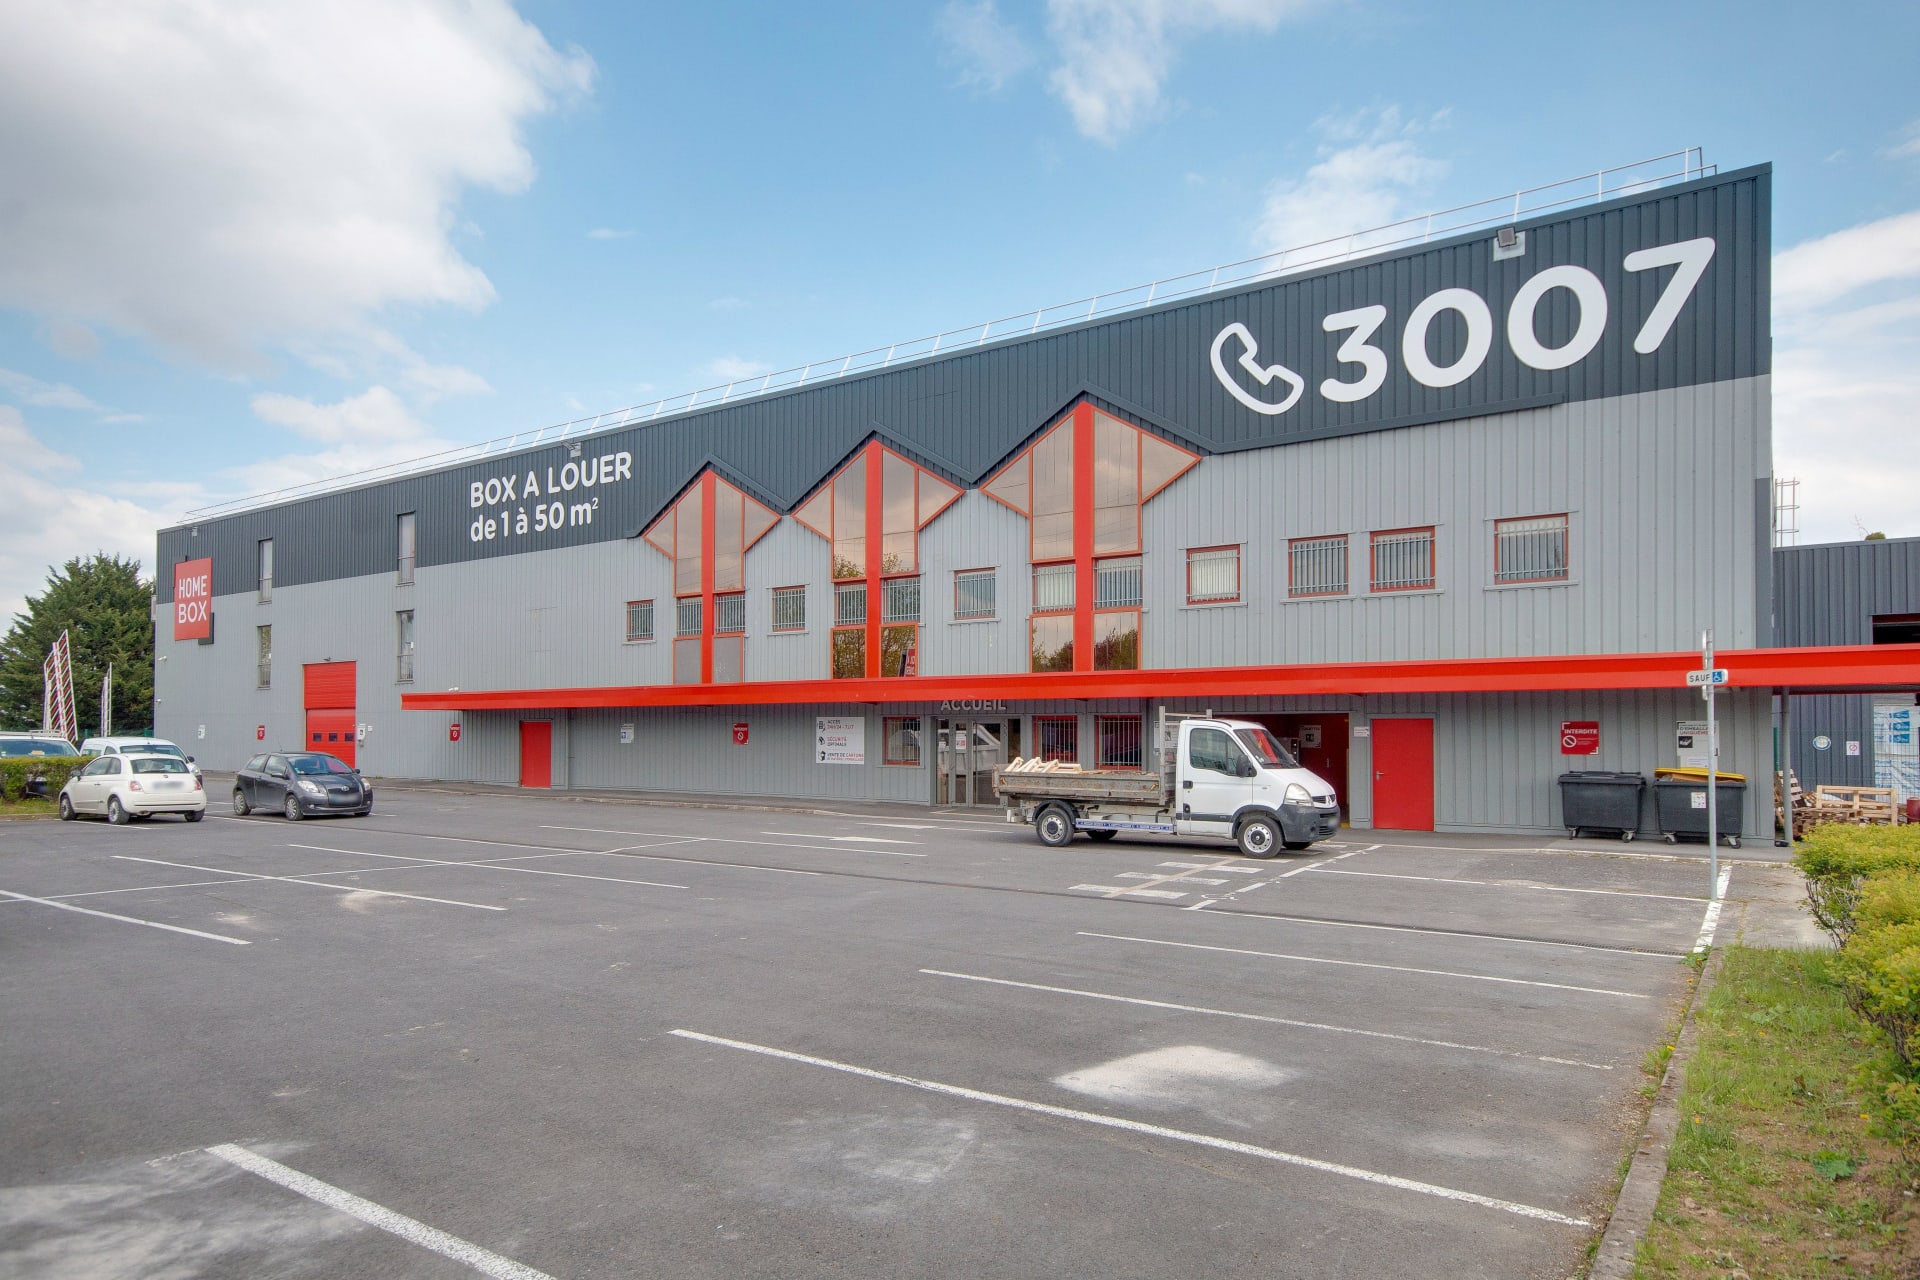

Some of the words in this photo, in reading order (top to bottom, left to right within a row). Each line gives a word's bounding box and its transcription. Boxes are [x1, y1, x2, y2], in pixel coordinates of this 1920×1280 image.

[1320, 237, 1716, 403] 3007
[470, 474, 517, 508] BOX
[523, 471, 540, 499] A
[547, 451, 632, 494] LOUER
[470, 514, 497, 542] de
[501, 510, 509, 537] 1
[515, 507, 528, 535] à
[535, 501, 565, 530] 50
[178, 575, 208, 599] HOME
[178, 600, 207, 624] BOX
[1689, 674, 1710, 682] SAUF
[940, 699, 1007, 711] ACCUEIL
